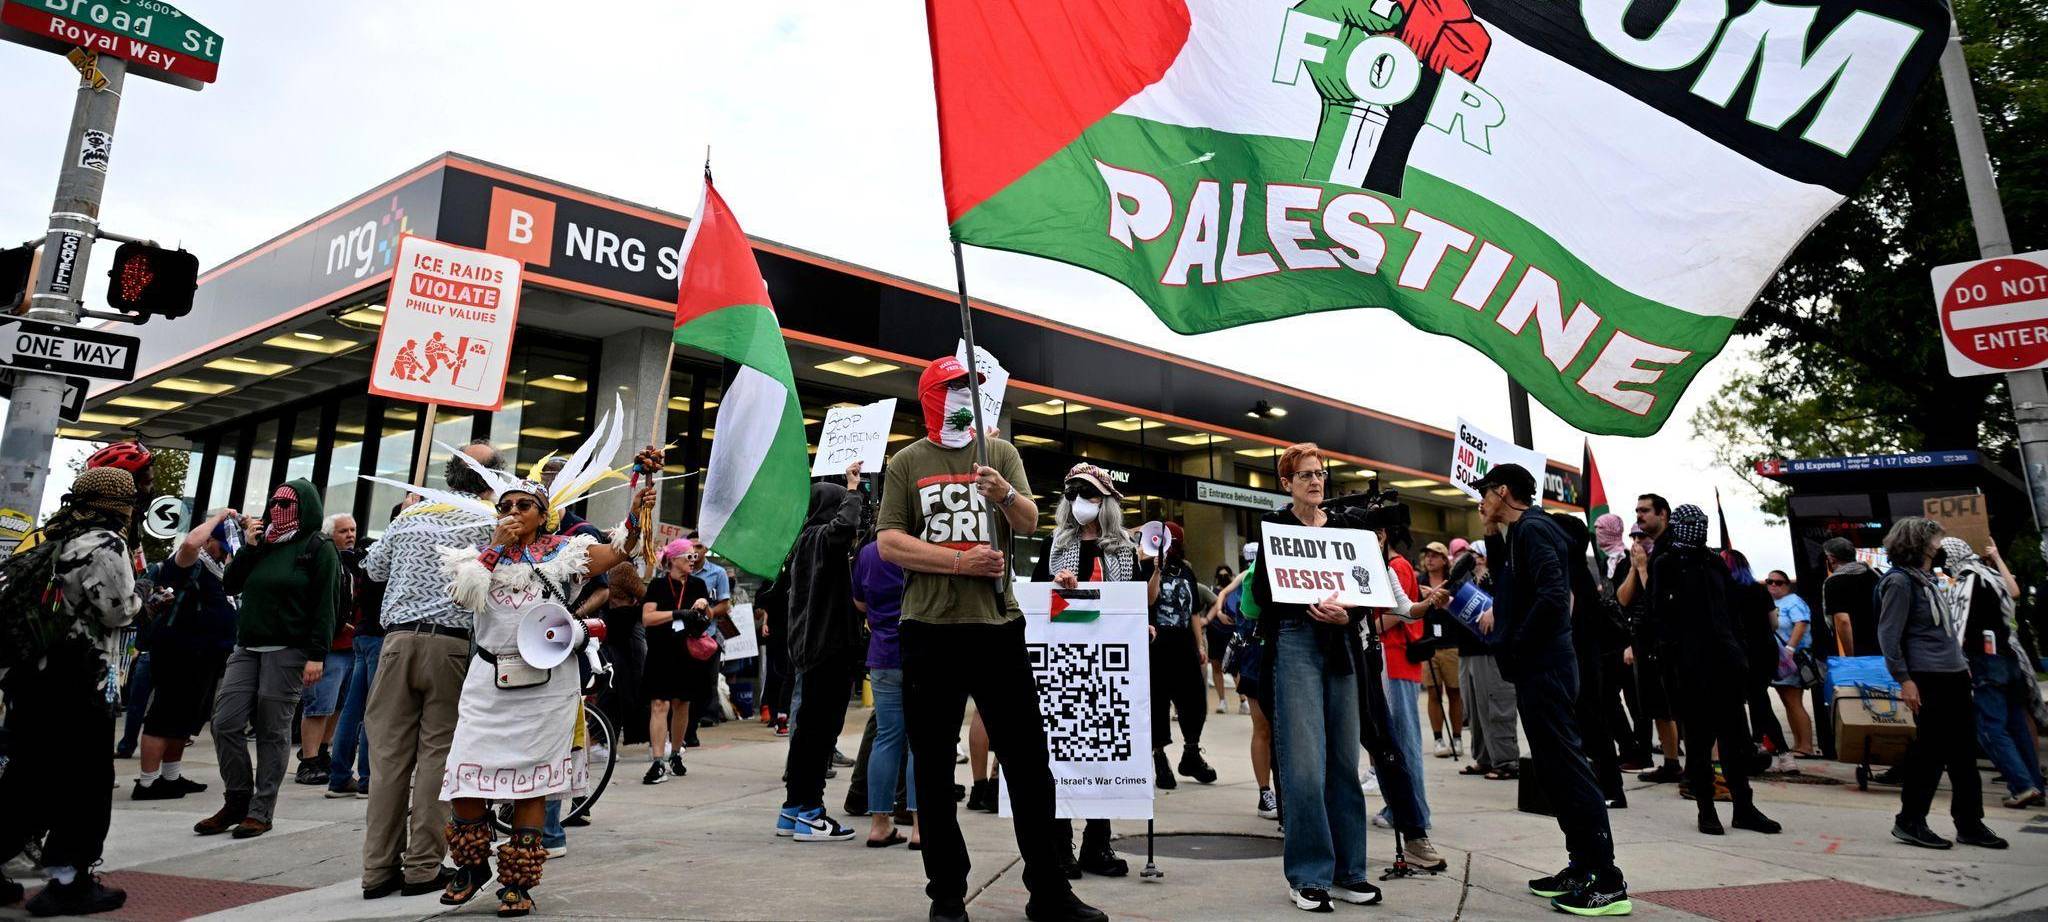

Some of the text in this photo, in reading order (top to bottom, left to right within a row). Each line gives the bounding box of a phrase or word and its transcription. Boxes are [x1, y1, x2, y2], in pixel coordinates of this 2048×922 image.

[136, 0, 170, 15] 3600
[49, 17, 119, 51] Royal
[129, 39, 176, 71] Way
[182, 29, 217, 57] St
[1272, 6, 1503, 154] FOR
[508, 208, 535, 245] B
[565, 222, 646, 273] NRG
[450, 262, 504, 284] RAIDS
[414, 276, 498, 306] VIOLATE
[1094, 158, 1692, 416] PALESTINE
[1955, 275, 2048, 304] DO NOT
[406, 298, 497, 324] PHILLY VALUES
[16, 334, 121, 365] ONE WAY
[1973, 326, 2048, 352] ENTER
[1460, 424, 1488, 454] Gaza:
[1457, 446, 1474, 468] AID
[1794, 463, 1804, 471] 68
[1806, 461, 1841, 470] Express
[1886, 457, 1896, 465] 17
[1110, 470, 1130, 483] ONLY
[1544, 473, 1564, 501] nrg
[1209, 488, 1274, 508] Entrance Behind Building
[1269, 535, 1357, 561] READY TO
[1274, 567, 1346, 592] RESIST
[1061, 777, 1093, 785] Israel's
[1095, 777, 1113, 785] War
[1114, 776, 1147, 785] Crimes
